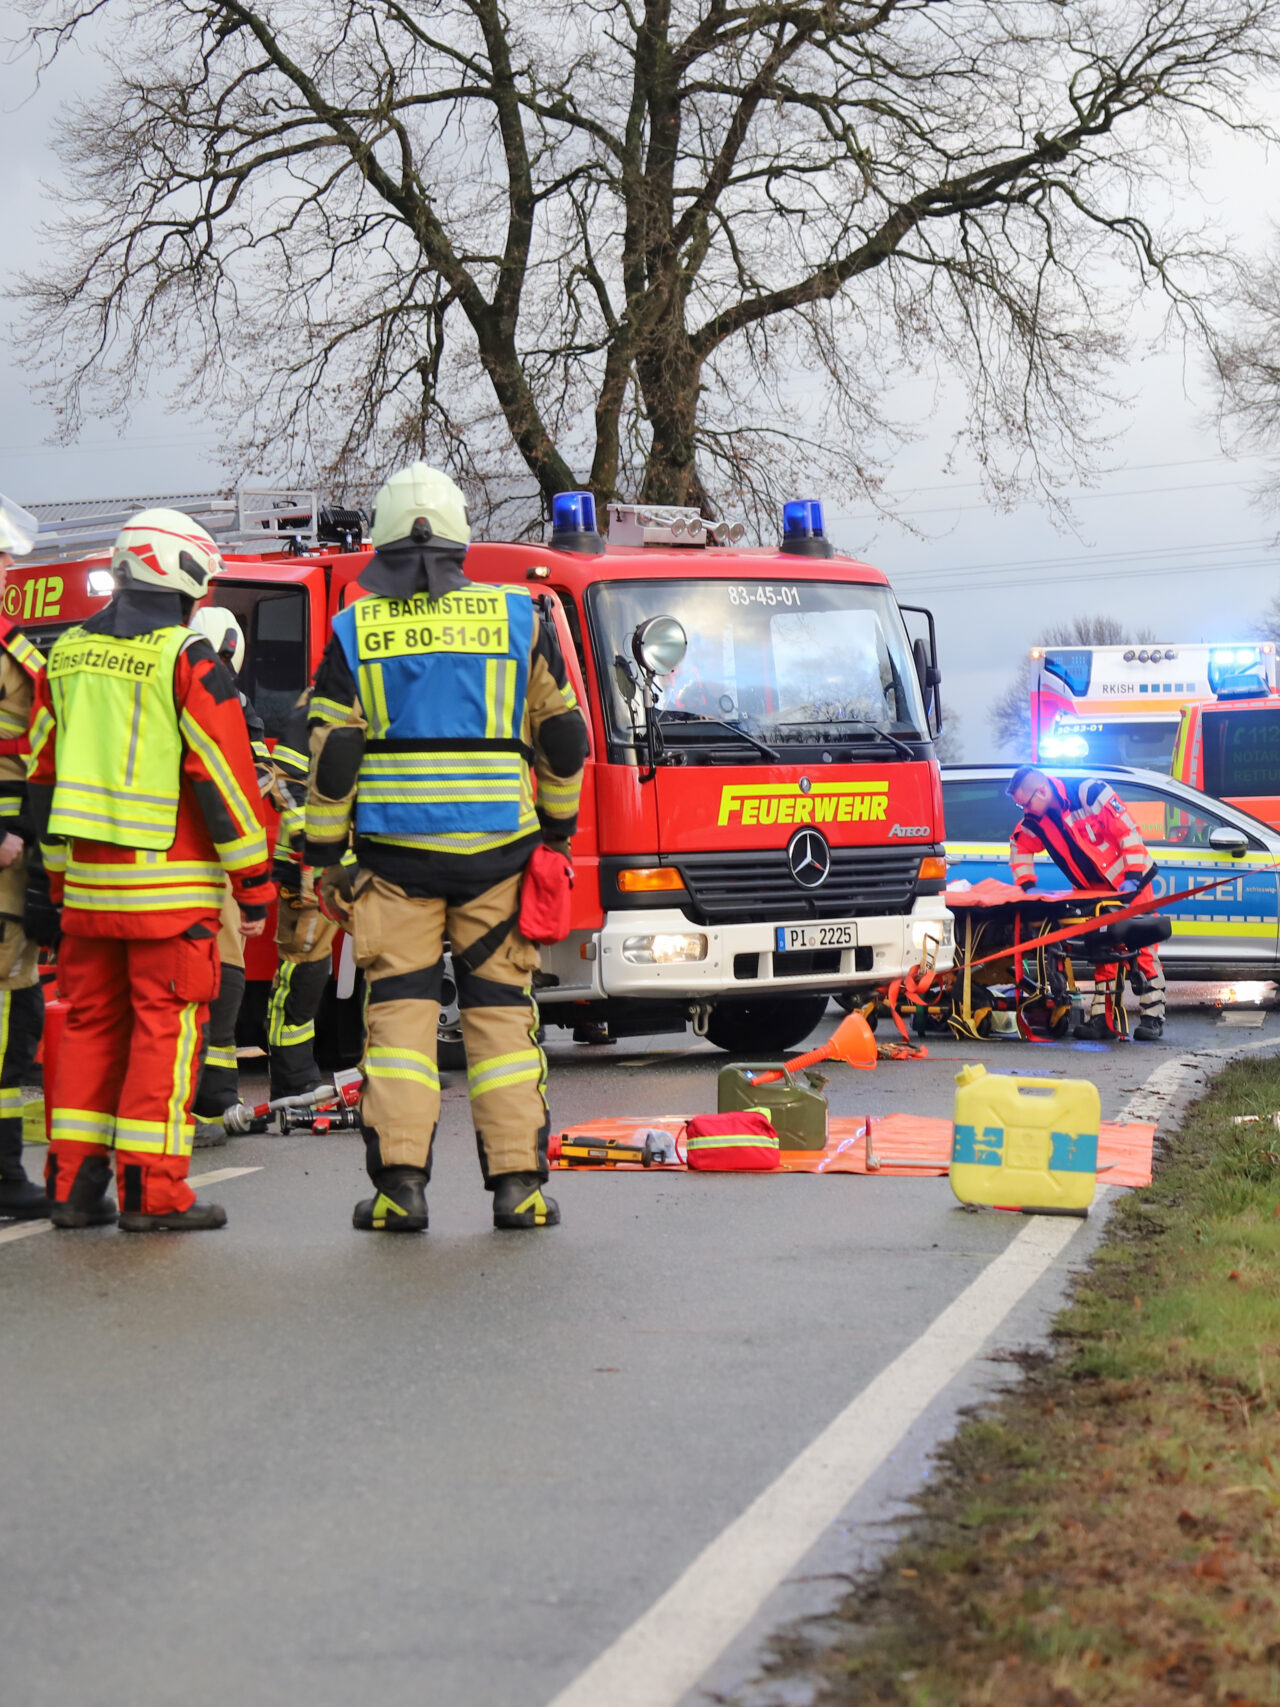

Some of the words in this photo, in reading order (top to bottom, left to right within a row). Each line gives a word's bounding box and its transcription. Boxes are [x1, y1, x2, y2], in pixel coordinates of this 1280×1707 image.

[22, 576, 64, 620] 112
[728, 585, 801, 606] 83-45-01
[361, 603, 381, 621] FF
[388, 597, 498, 618] BARMSTEDT
[364, 630, 395, 652] GF
[404, 626, 502, 648] 80-51-01
[51, 650, 156, 678] Einsatzleiter
[1250, 726, 1280, 744] 112
[1153, 874, 1243, 901] OLIZEI
[789, 930, 807, 947] PI
[820, 927, 851, 946] 2225
